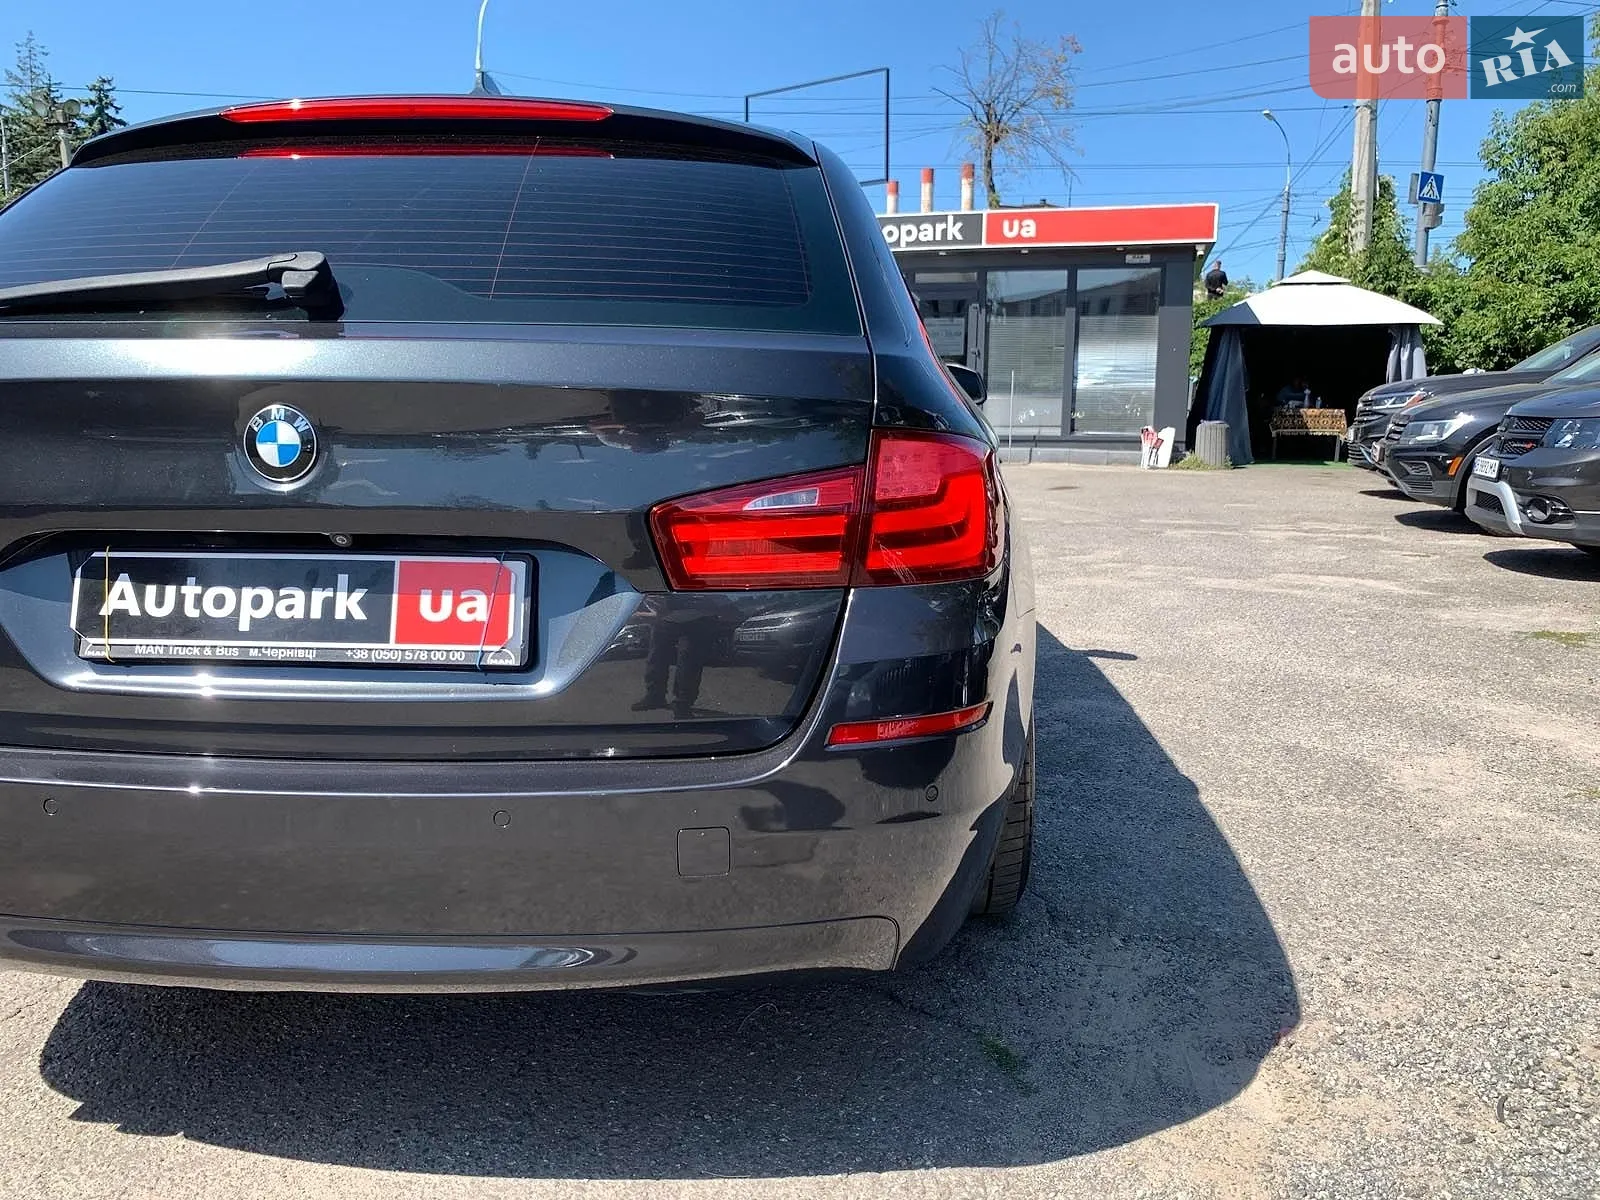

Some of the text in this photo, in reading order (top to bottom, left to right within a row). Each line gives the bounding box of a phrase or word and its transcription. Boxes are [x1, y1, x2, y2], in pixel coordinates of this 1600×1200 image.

[1002, 218, 1037, 239] ua
[249, 407, 310, 433] BMW
[99, 573, 489, 632] Autopark ua
[134, 645, 239, 656] MAN Truck & Bus
[345, 649, 466, 662] +38 (050) 578 00 00
